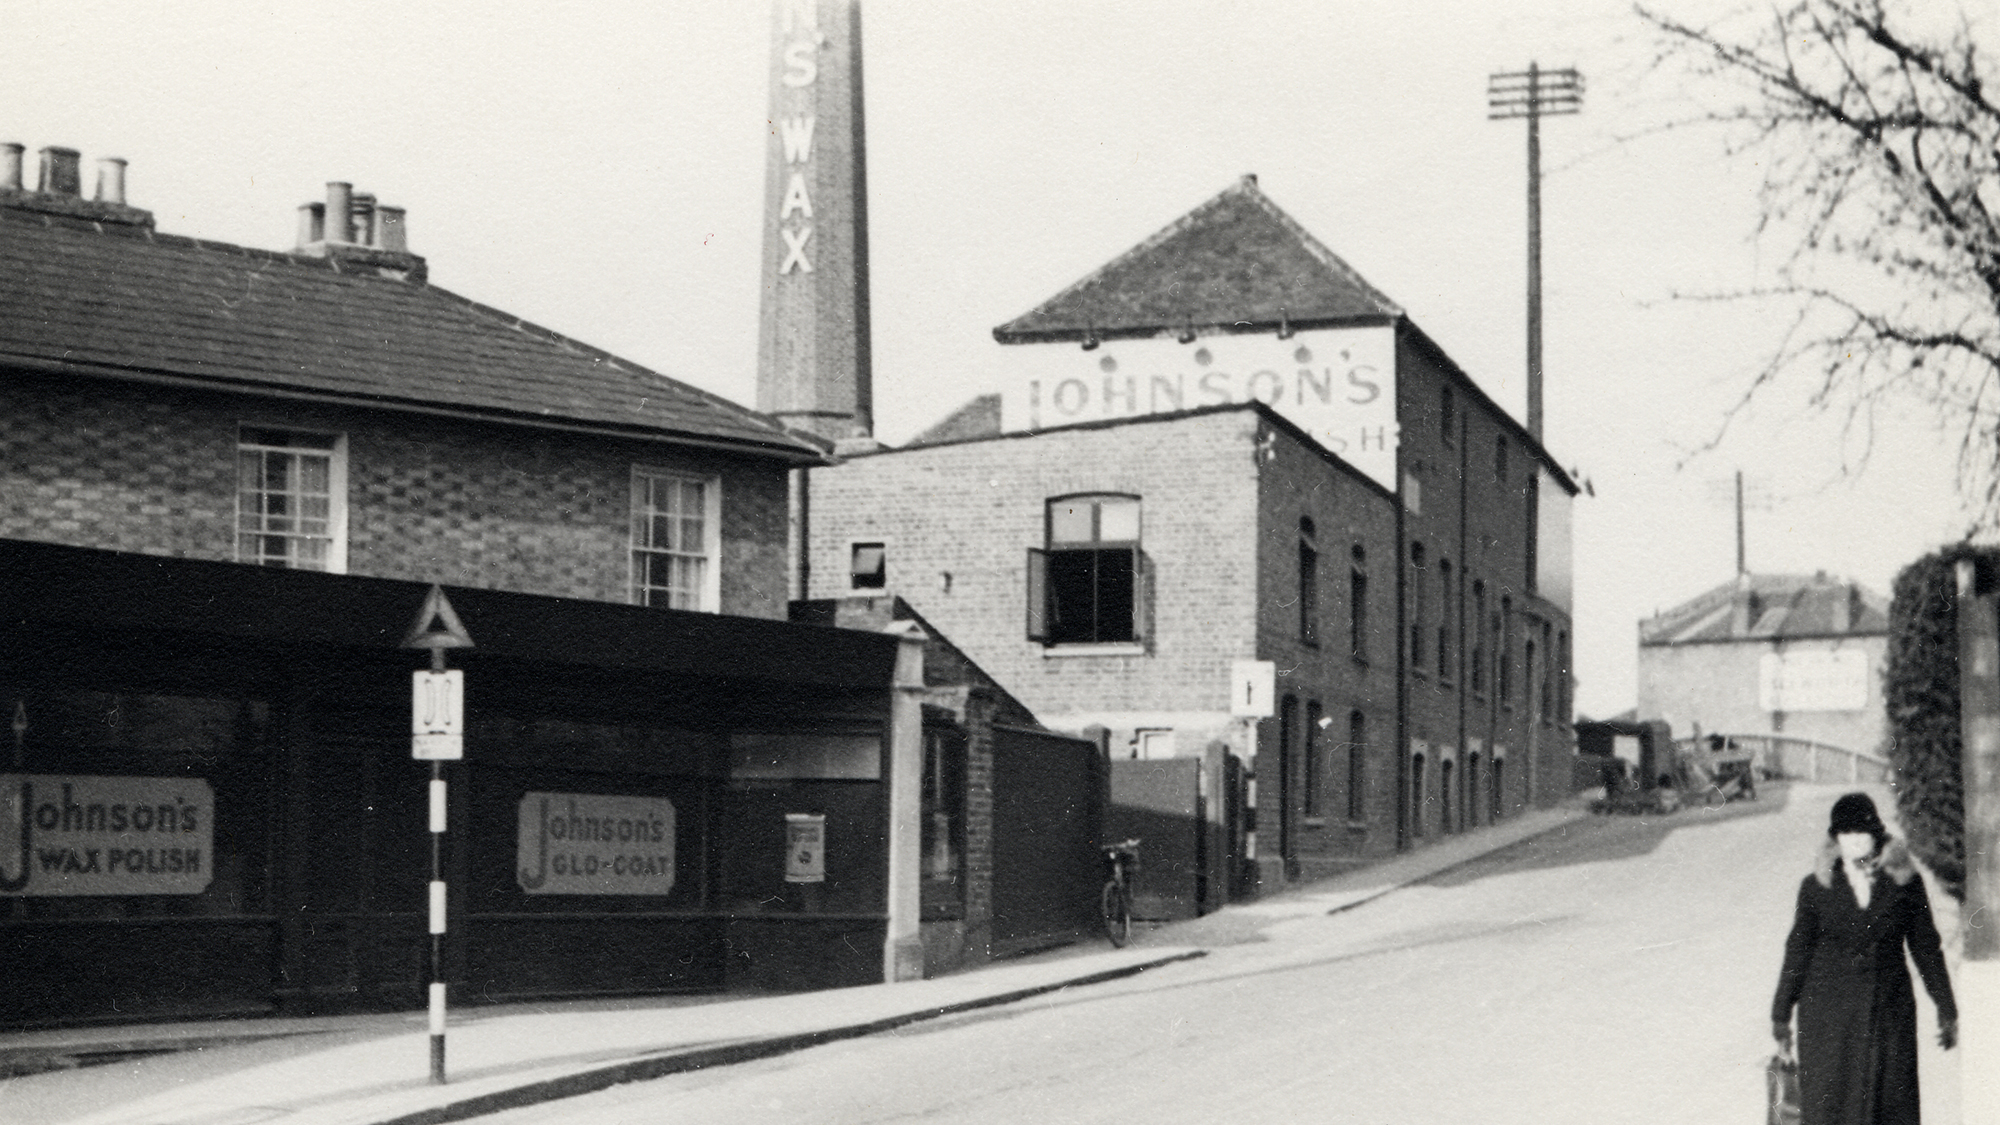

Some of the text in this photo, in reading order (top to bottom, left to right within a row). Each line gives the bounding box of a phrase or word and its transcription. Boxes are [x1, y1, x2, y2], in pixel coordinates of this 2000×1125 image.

[779, 116, 815, 275] WAX
[0, 783, 198, 892] Johnson's
[37, 848, 201, 874] WAX POLISH
[519, 798, 664, 890] Johnson's
[552, 853, 669, 876] GLO-COAT
